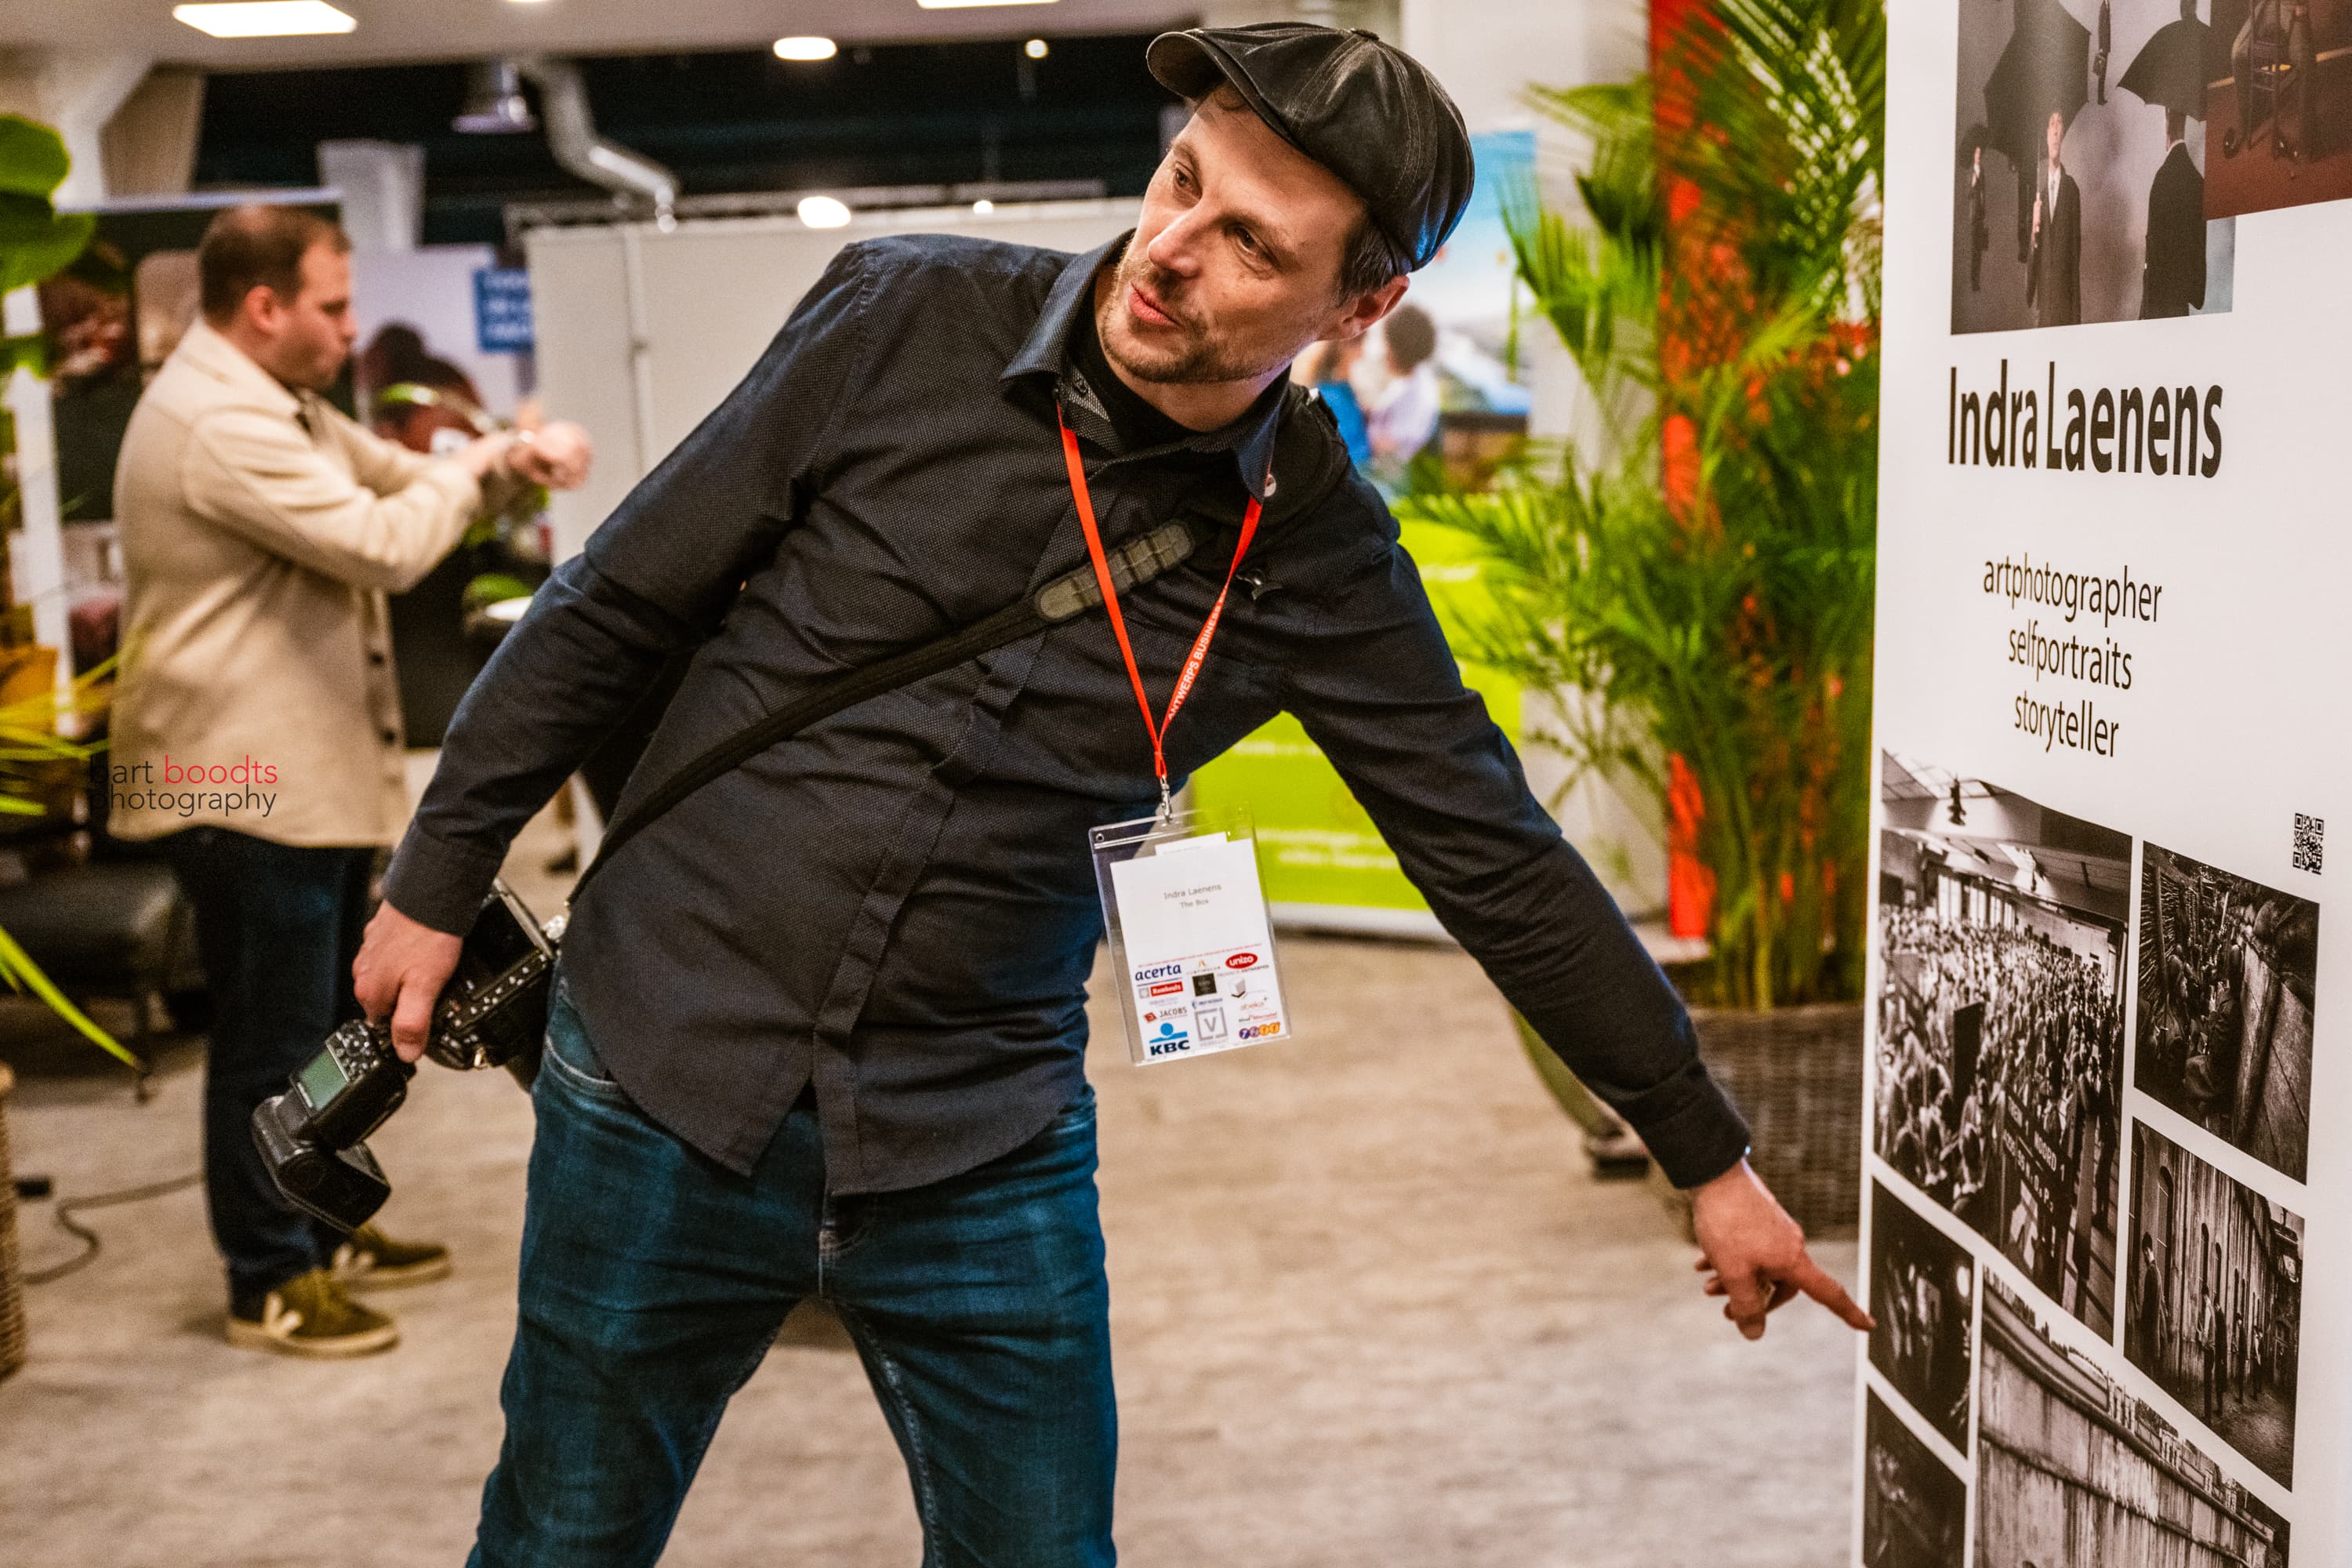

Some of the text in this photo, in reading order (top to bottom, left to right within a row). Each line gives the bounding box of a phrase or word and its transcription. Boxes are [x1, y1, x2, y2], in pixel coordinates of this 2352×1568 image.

[1948, 358, 2223, 478] Indra Laenens
[1983, 551, 2163, 627] artphotographer
[1168, 605, 1221, 720] ANTWERPS BUSINESS
[2009, 619, 2132, 690] selfportraits
[2014, 690, 2119, 757] storyteller
[1163, 884, 1222, 900] Indra Laenens
[1135, 964, 1181, 981] acerta
[1229, 955, 1254, 967] unizo
[1160, 1007, 1188, 1018] JACOBS
[1150, 1040, 1190, 1056] KBC
